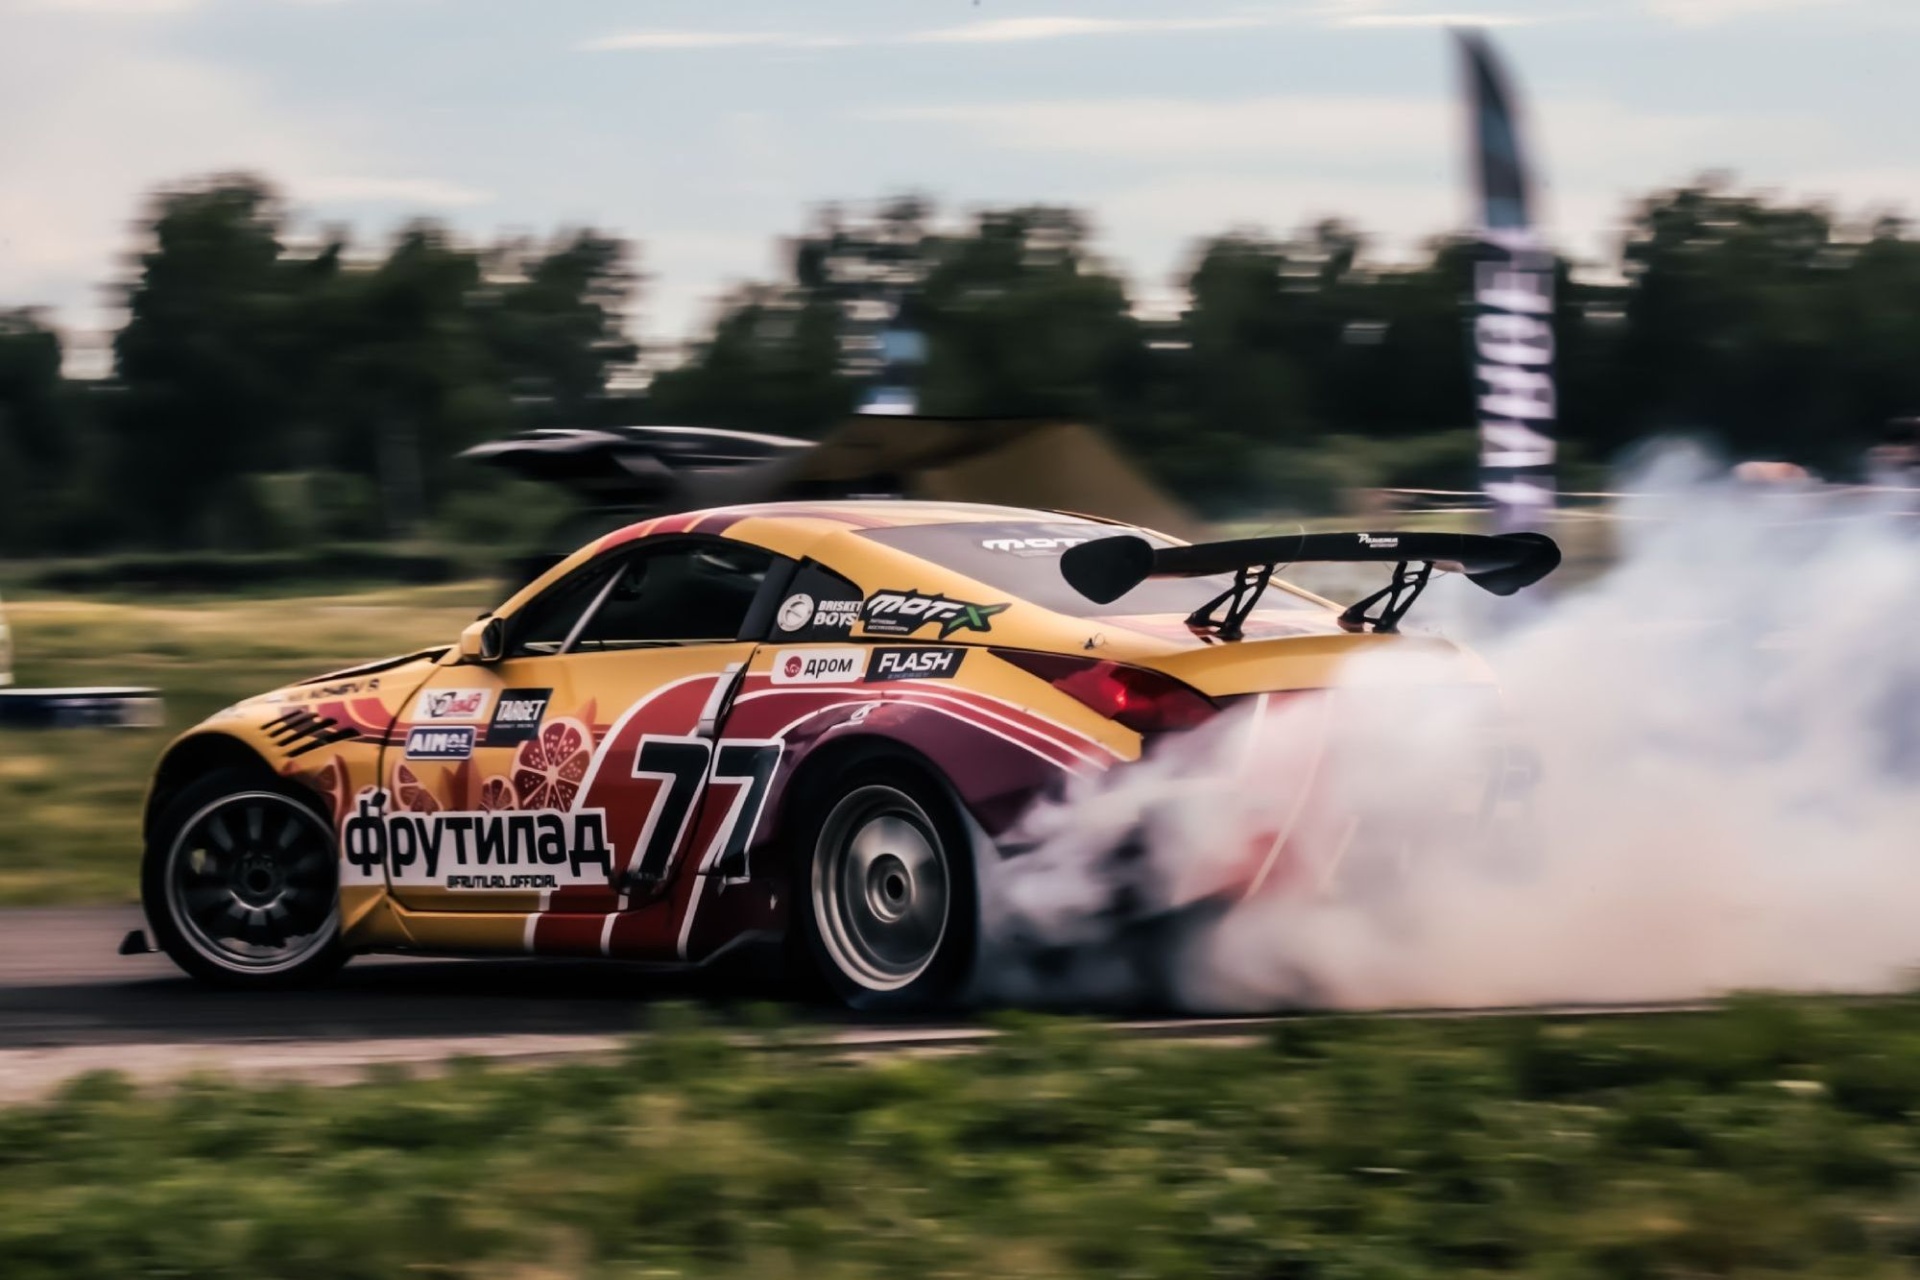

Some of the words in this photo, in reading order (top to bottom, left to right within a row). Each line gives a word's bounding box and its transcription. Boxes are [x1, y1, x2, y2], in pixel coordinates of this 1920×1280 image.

[818, 600, 862, 611] BRISKET
[813, 611, 857, 628] BOYS
[878, 652, 953, 673] FLASH
[496, 700, 546, 721] TARGET
[632, 735, 785, 883] 77
